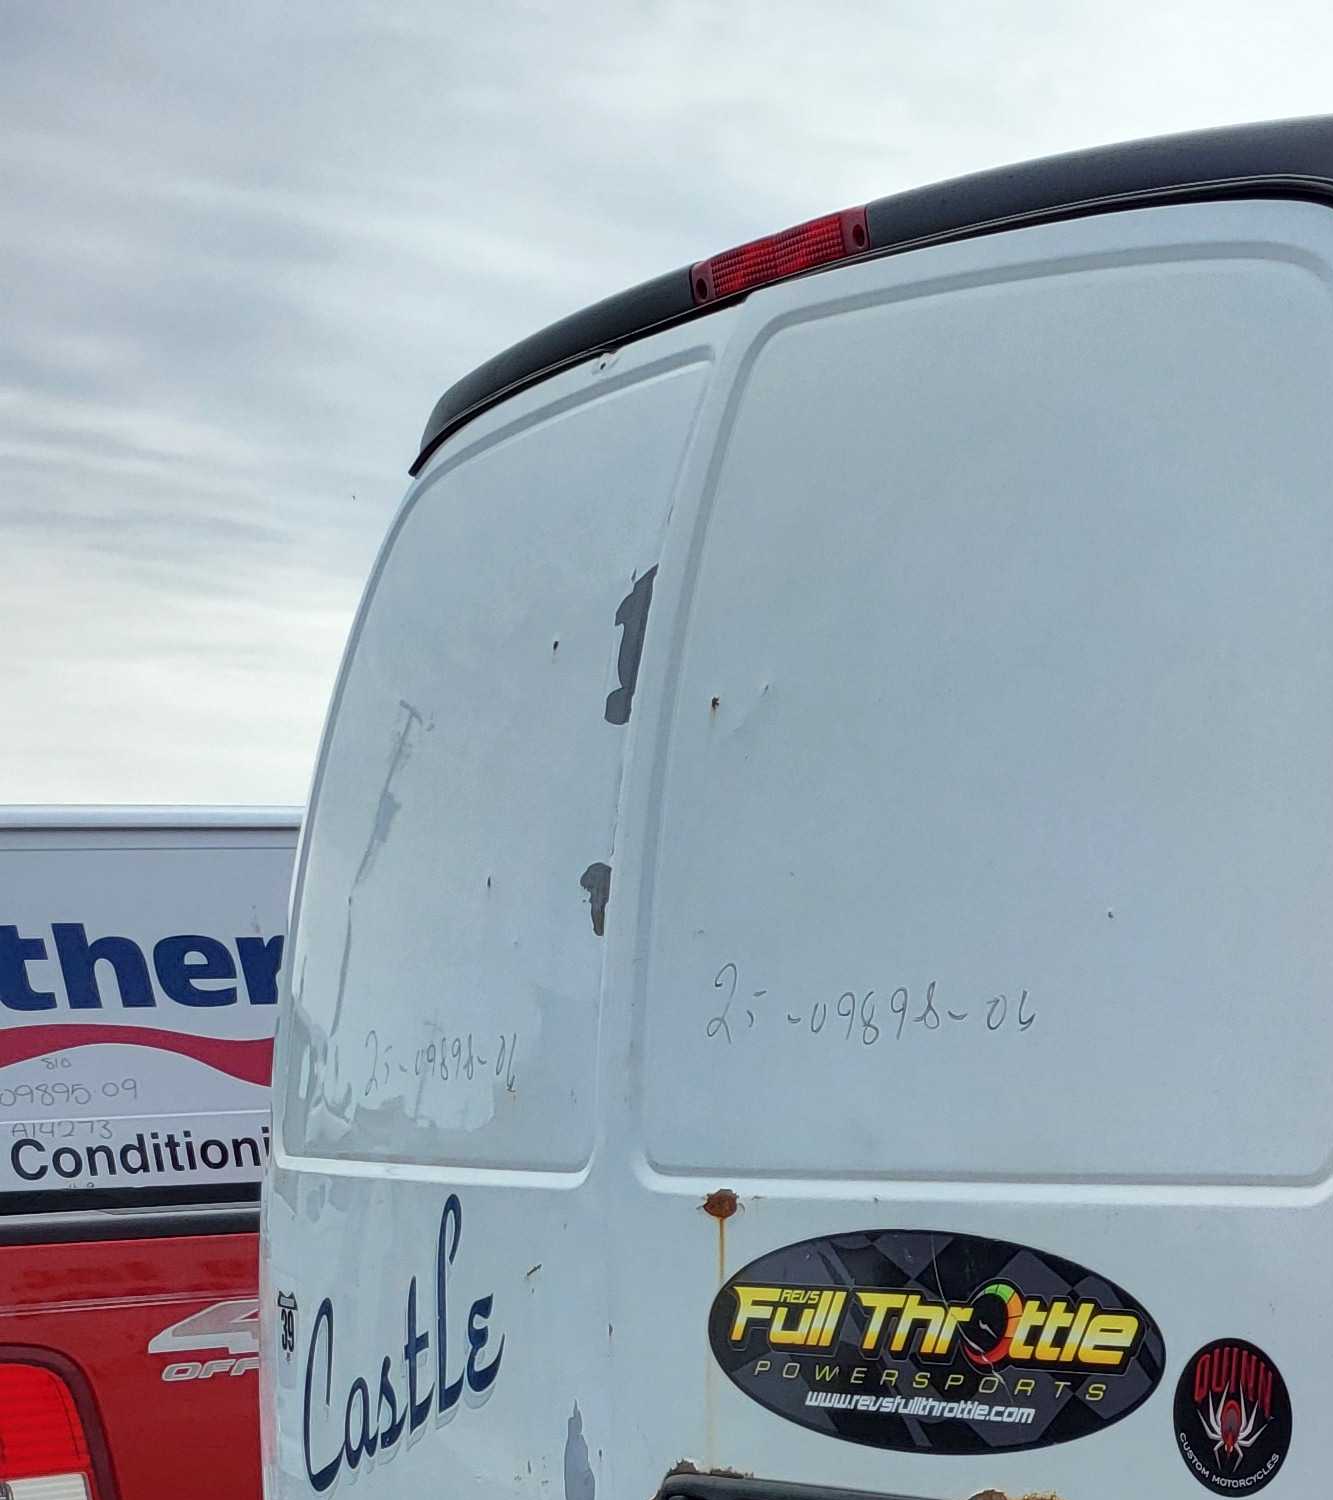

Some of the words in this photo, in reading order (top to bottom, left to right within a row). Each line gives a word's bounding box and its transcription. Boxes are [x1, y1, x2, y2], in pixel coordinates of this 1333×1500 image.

[780, 1289, 821, 1305] REVS
[280, 1308, 295, 1353] 39
[303, 1193, 506, 1492] Castle
[730, 1285, 849, 1347] Full
[854, 1282, 1140, 1366] Throttle
[752, 1360, 1107, 1401] POWERSPORTS
[804, 1390, 1036, 1425] www.revsfullthrottle.com
[1179, 1431, 1211, 1478] CUSTOM
[1211, 1453, 1280, 1489] MOTORCYCLES
